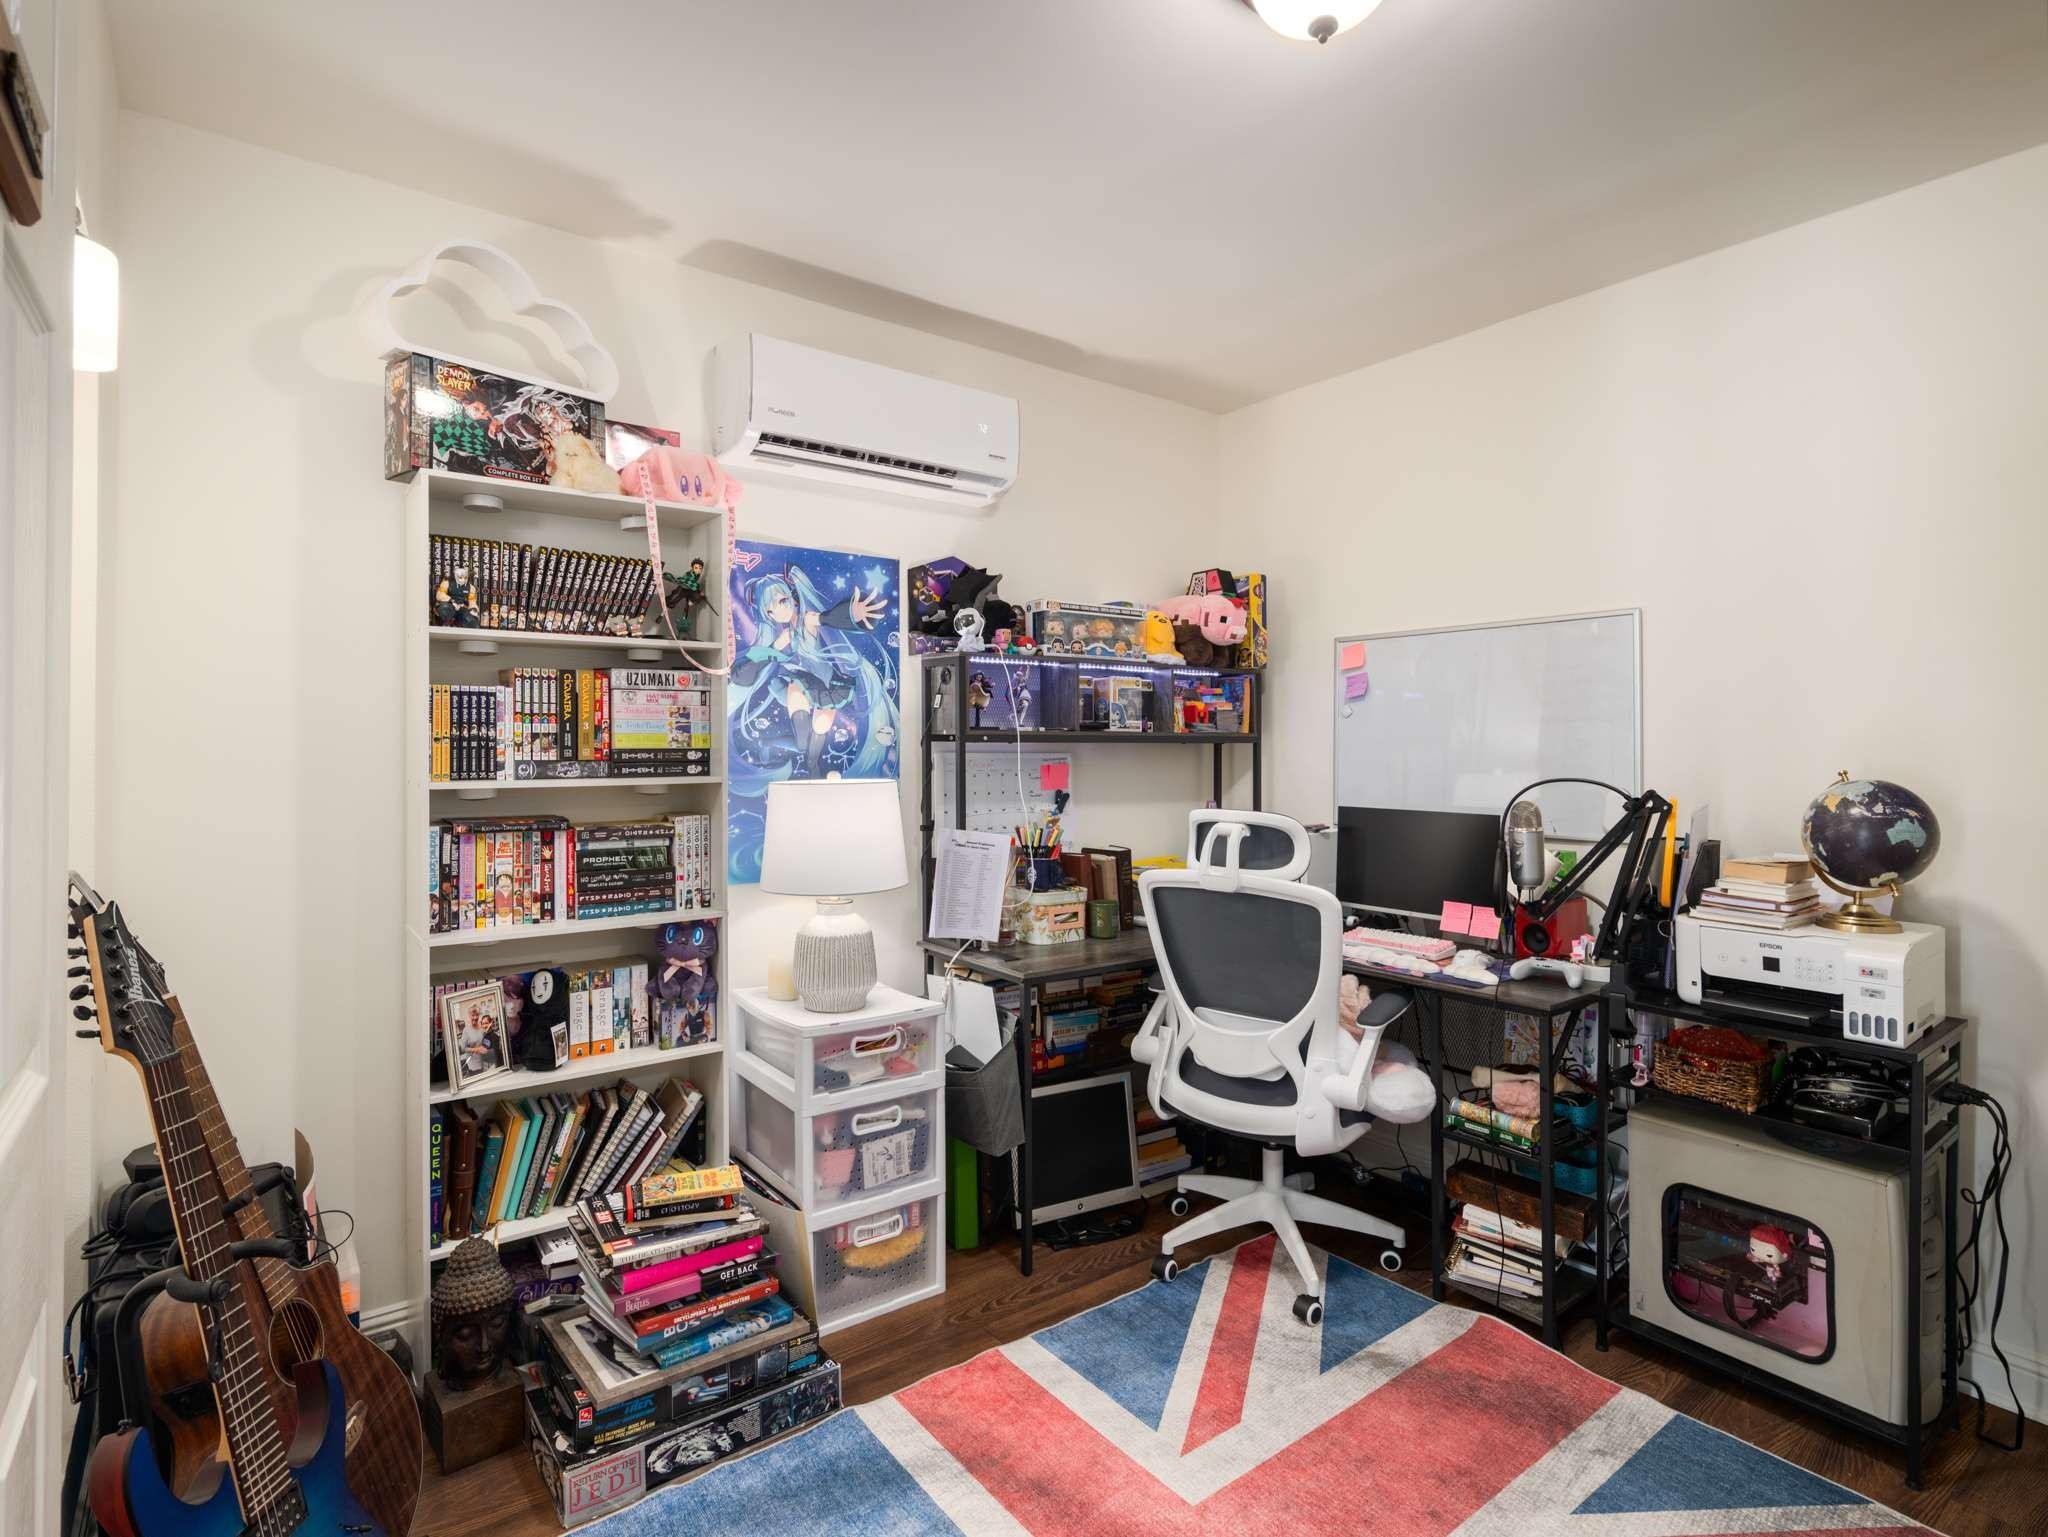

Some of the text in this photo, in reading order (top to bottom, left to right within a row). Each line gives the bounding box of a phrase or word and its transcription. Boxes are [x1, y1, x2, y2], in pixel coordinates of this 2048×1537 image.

[438, 364, 470, 380] DEMON
[436, 374, 471, 392] SLAYER
[488, 468, 518, 480] COMPLETE
[519, 474, 532, 482] BOX
[626, 672, 675, 686] UZUMAKI
[583, 855, 634, 864] PROPHECY
[1759, 942, 1782, 950] EPSON
[128, 947, 144, 1002] Ibanez
[573, 993, 582, 1031] orange
[597, 990, 606, 1026] orange
[432, 1124, 442, 1180] QUEEN
[670, 1202, 700, 1214] APOLLO
[720, 1262, 758, 1280] GET BACK
[626, 1298, 650, 1313] BEATLES
[674, 1310, 706, 1324] ENCYCLOPEDIA
[708, 1305, 717, 1313] FOR
[718, 1296, 750, 1310] MINECRAFTERS
[574, 1468, 608, 1488] RETURN
[608, 1464, 622, 1475] OF
[622, 1456, 638, 1469] THE
[572, 1465, 638, 1506] JEDI
